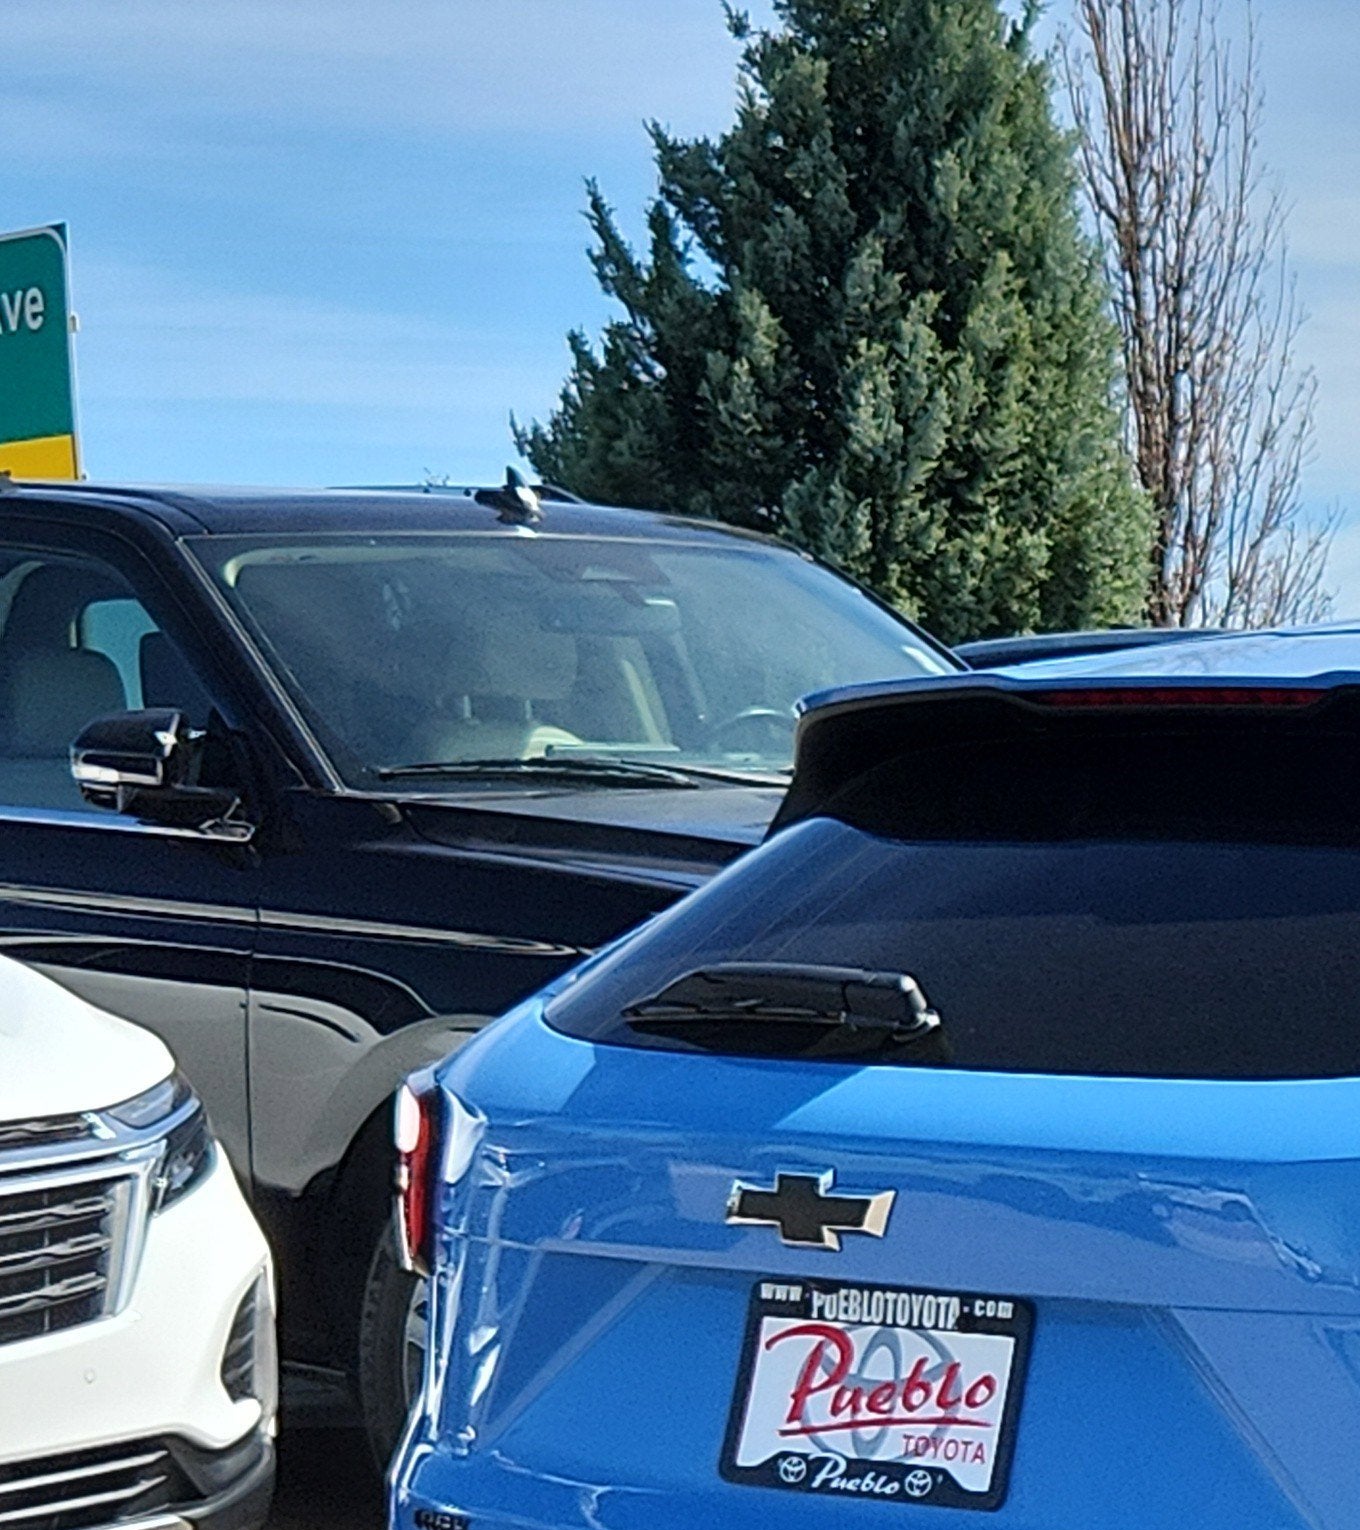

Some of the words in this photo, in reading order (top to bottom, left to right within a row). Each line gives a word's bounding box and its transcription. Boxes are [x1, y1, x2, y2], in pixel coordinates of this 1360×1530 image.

[0, 286, 45, 335] ve
[765, 1323, 997, 1424] Pueblo
[902, 1434, 986, 1464] TOYOTA
[808, 1453, 900, 1494] Pueblo
